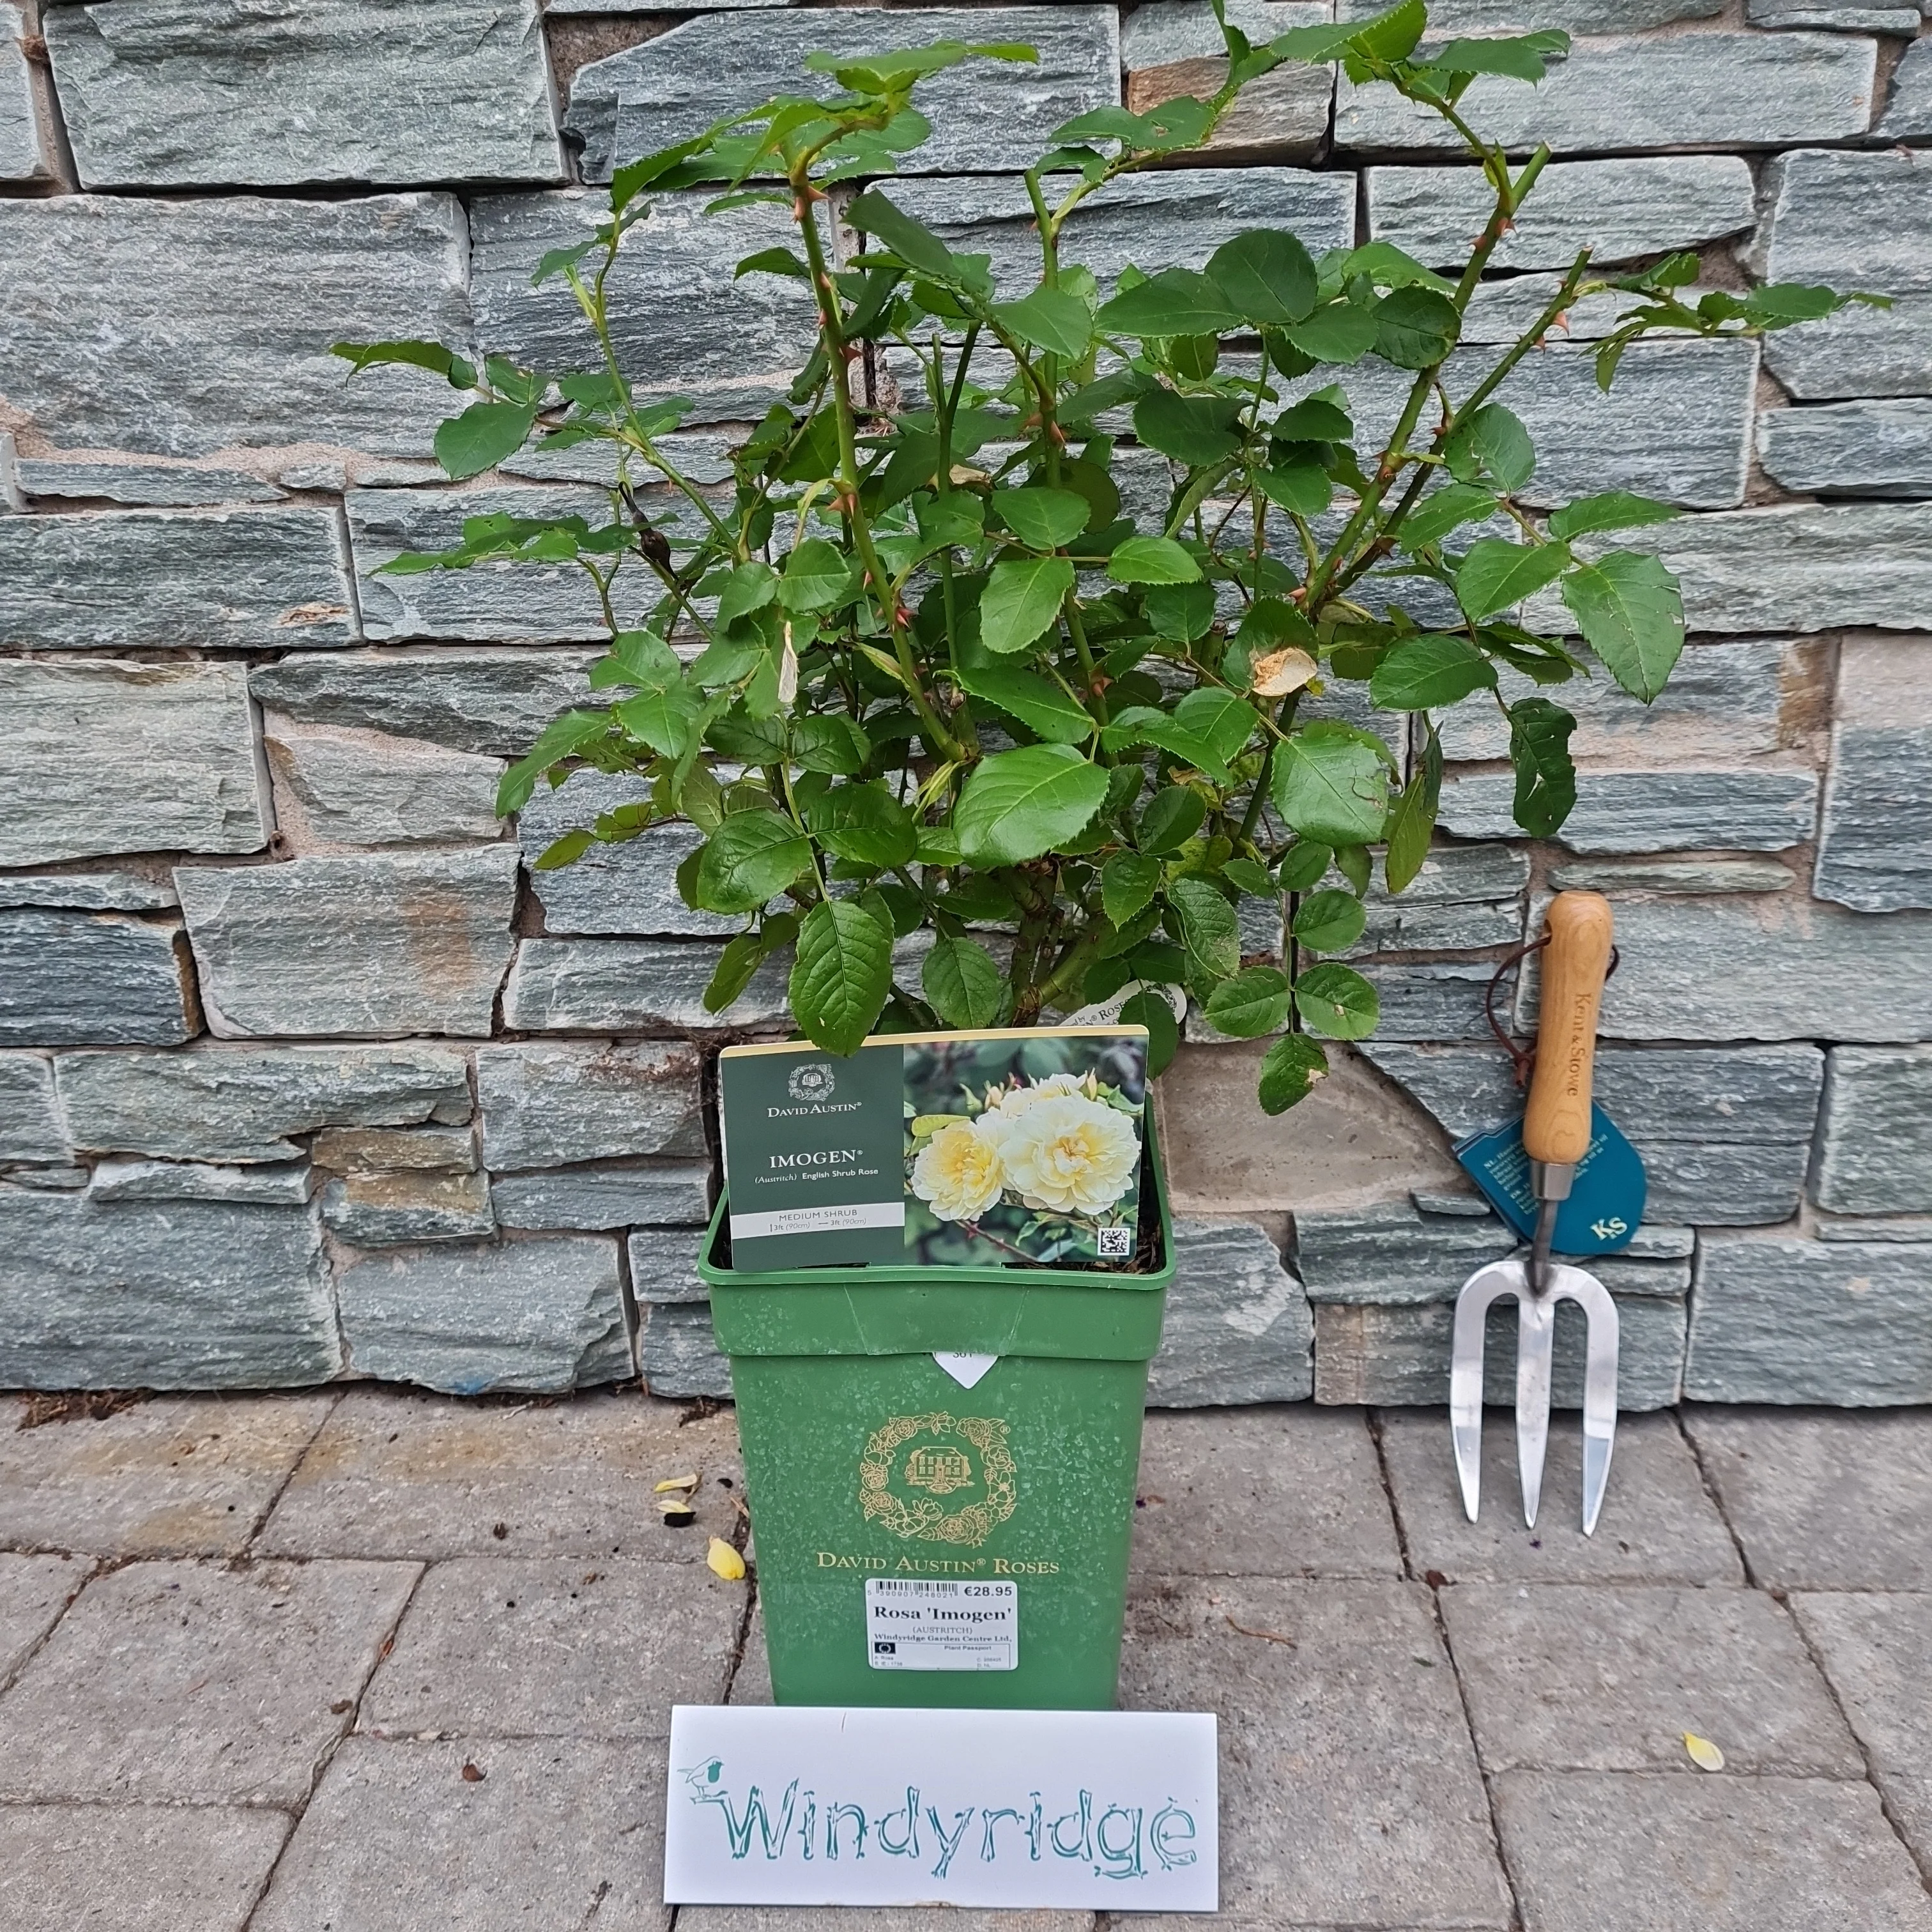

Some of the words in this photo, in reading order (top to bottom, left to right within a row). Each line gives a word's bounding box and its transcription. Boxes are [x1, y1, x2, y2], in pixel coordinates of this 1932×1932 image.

[1573, 993, 1592, 1031] Kent
[1572, 1034, 1583, 1044] &
[1567, 1047, 1587, 1097] Stowe
[767, 1107, 808, 1118] DAVID
[755, 1173, 797, 1184] (Austritch)
[802, 1170, 830, 1181] English
[832, 1169, 856, 1177] Shrub
[779, 1211, 820, 1222] MEDIUM
[824, 1209, 858, 1218] SHRUB
[786, 1222, 810, 1231] (90cm)
[842, 1218, 867, 1226] (90cm)
[816, 1552, 887, 1569] DAVID
[993, 1558, 1060, 1574] ROSES
[964, 1586, 1012, 1597] €28.95
[874, 1606, 921, 1620] Rosa
[927, 1607, 1011, 1624] 'Imogen'
[912, 1626, 973, 1635] (AUSTRITCH)
[874, 1633, 926, 1642] Windyridge
[691, 1777, 1198, 1880] Windyridge
